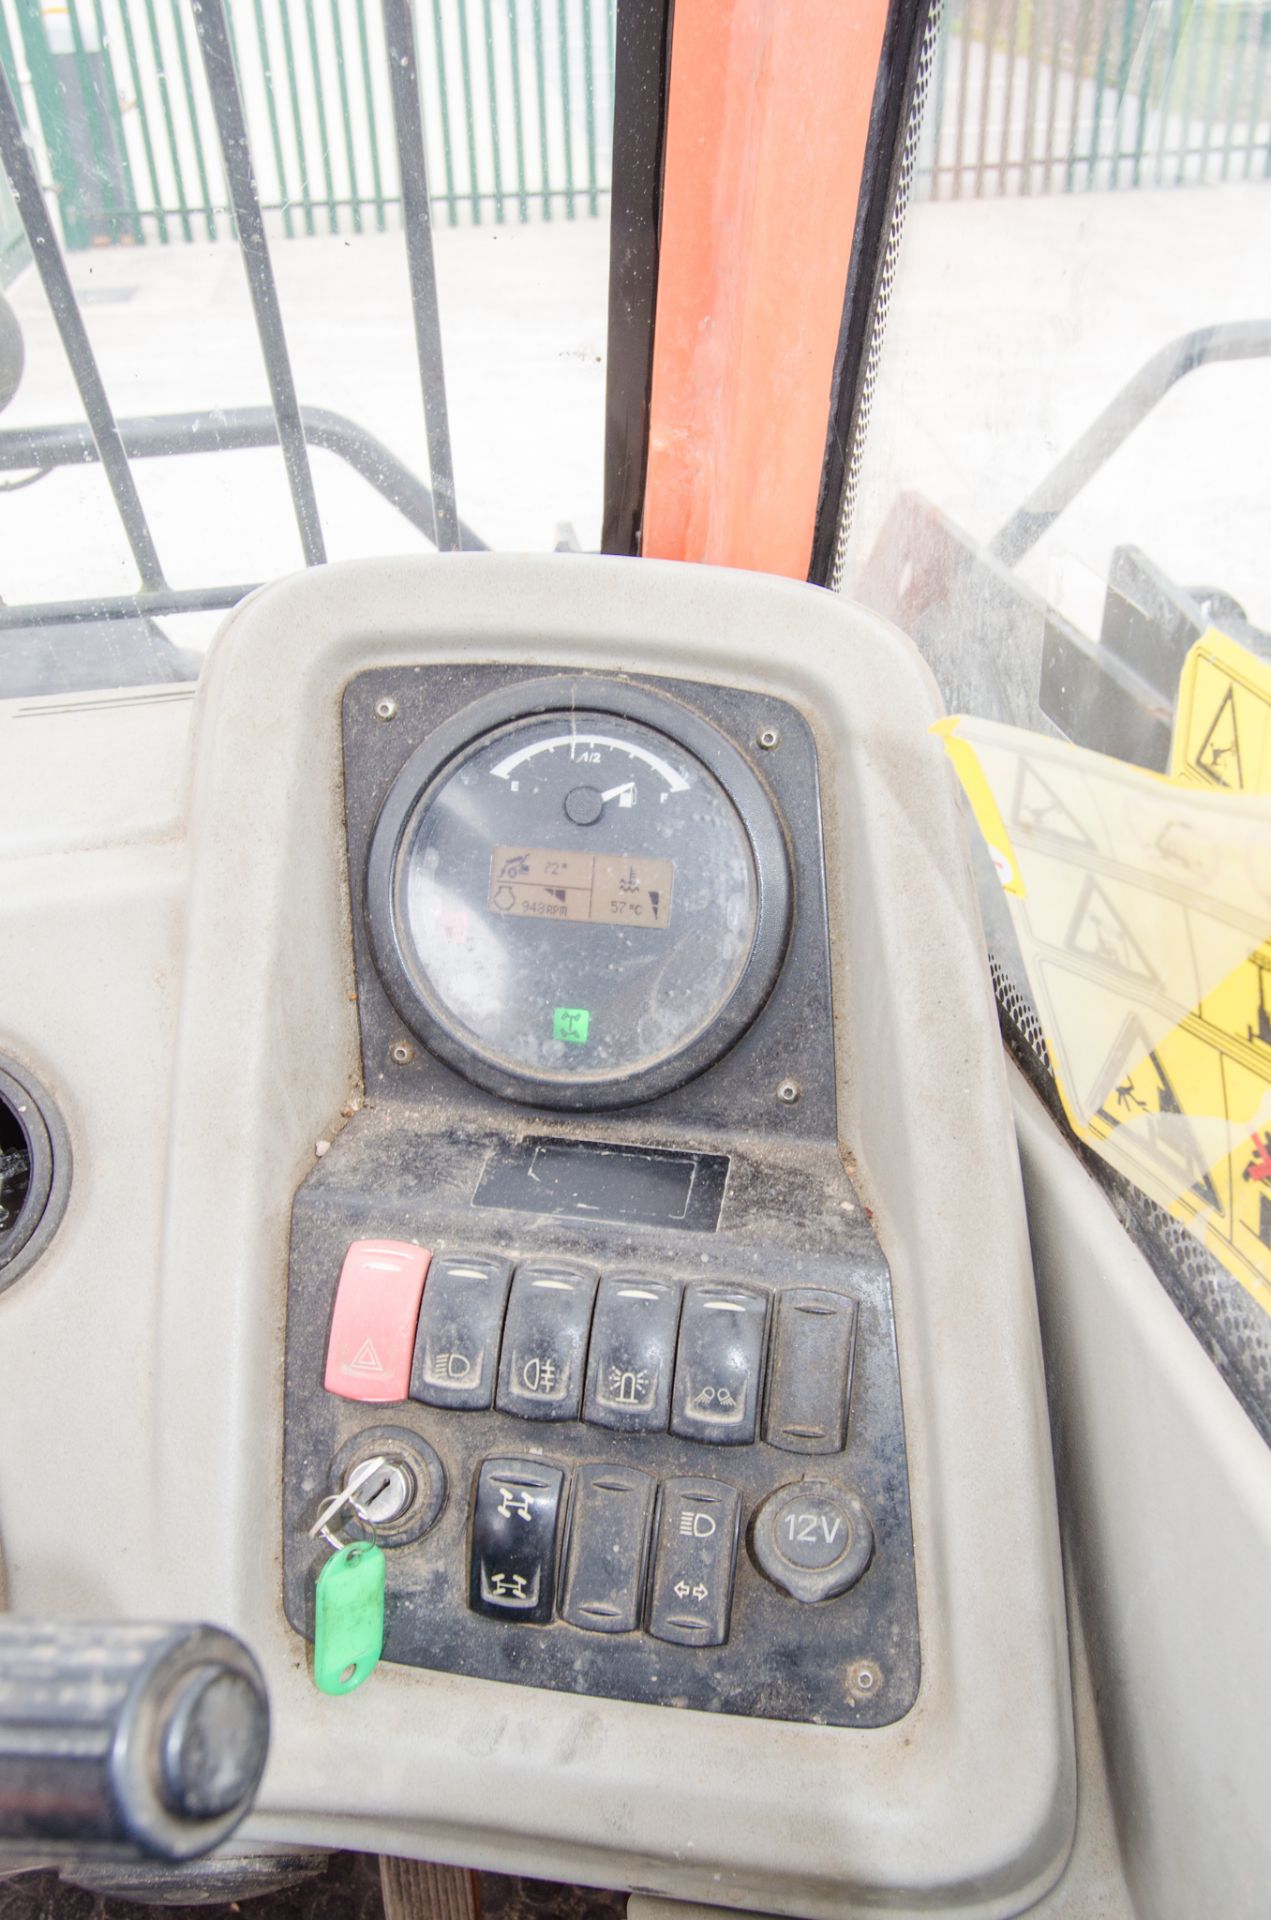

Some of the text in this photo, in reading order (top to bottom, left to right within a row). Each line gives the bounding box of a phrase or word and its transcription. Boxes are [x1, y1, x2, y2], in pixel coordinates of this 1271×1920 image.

[578, 751, 601, 763] 1/2
[510, 780, 519, 792] E
[660, 792, 668, 804] F
[784, 1514, 841, 1544] 12V
